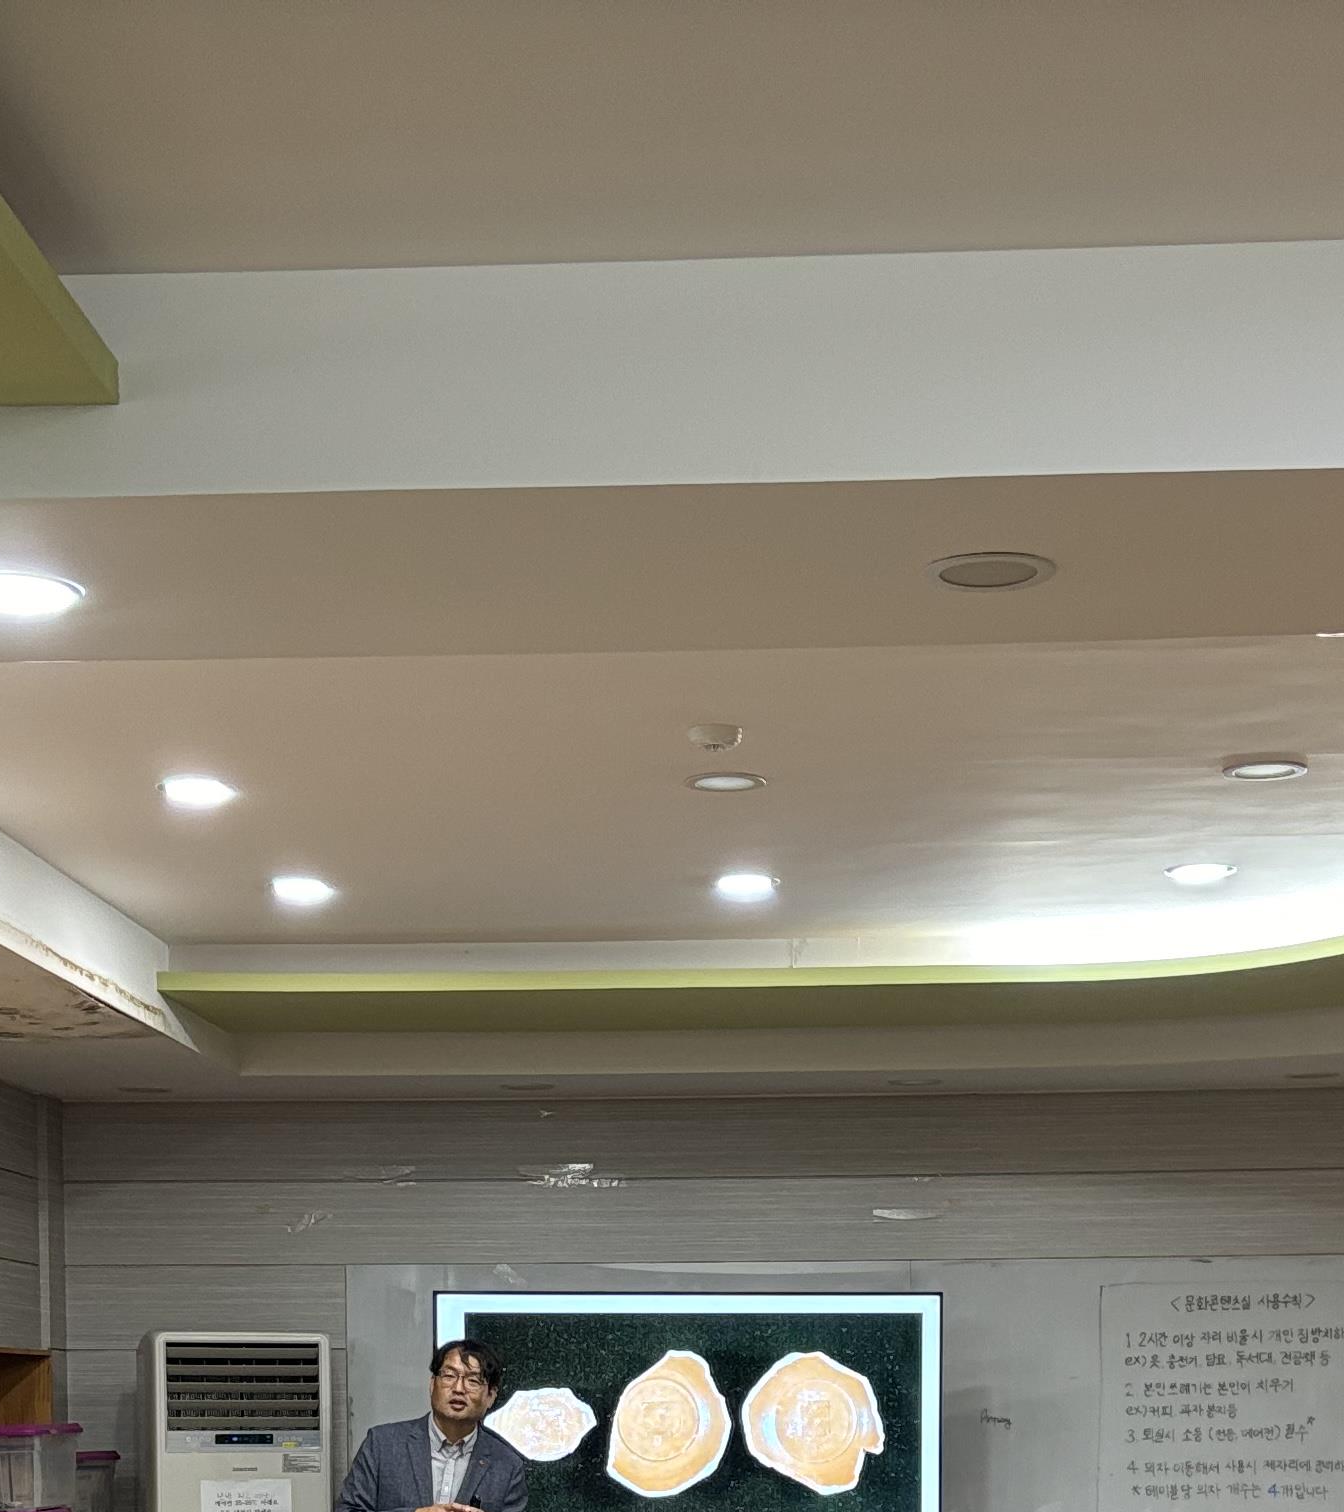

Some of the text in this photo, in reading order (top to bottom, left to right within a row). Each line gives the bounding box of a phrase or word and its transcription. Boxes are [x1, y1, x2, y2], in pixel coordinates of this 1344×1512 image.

[1173, 1333, 1195, 1349] 이상
[1200, 1331, 1222, 1345] 자리
[1269, 1328, 1294, 1345] 개인
[1320, 1350, 1331, 1367] 등
[1217, 1380, 1251, 1397] 본인이
[1256, 1378, 1294, 1393] 치우기
[1182, 1427, 1203, 1442] 소등
[1144, 1461, 1170, 1477] 의자
[1173, 1460, 1220, 1478] 이동해서
[1225, 1459, 1257, 1476] 사용시
[1263, 1459, 1311, 1473] 제자리에
[1196, 1483, 1222, 1500] 의자
[1226, 1482, 1262, 1501] 개수는
